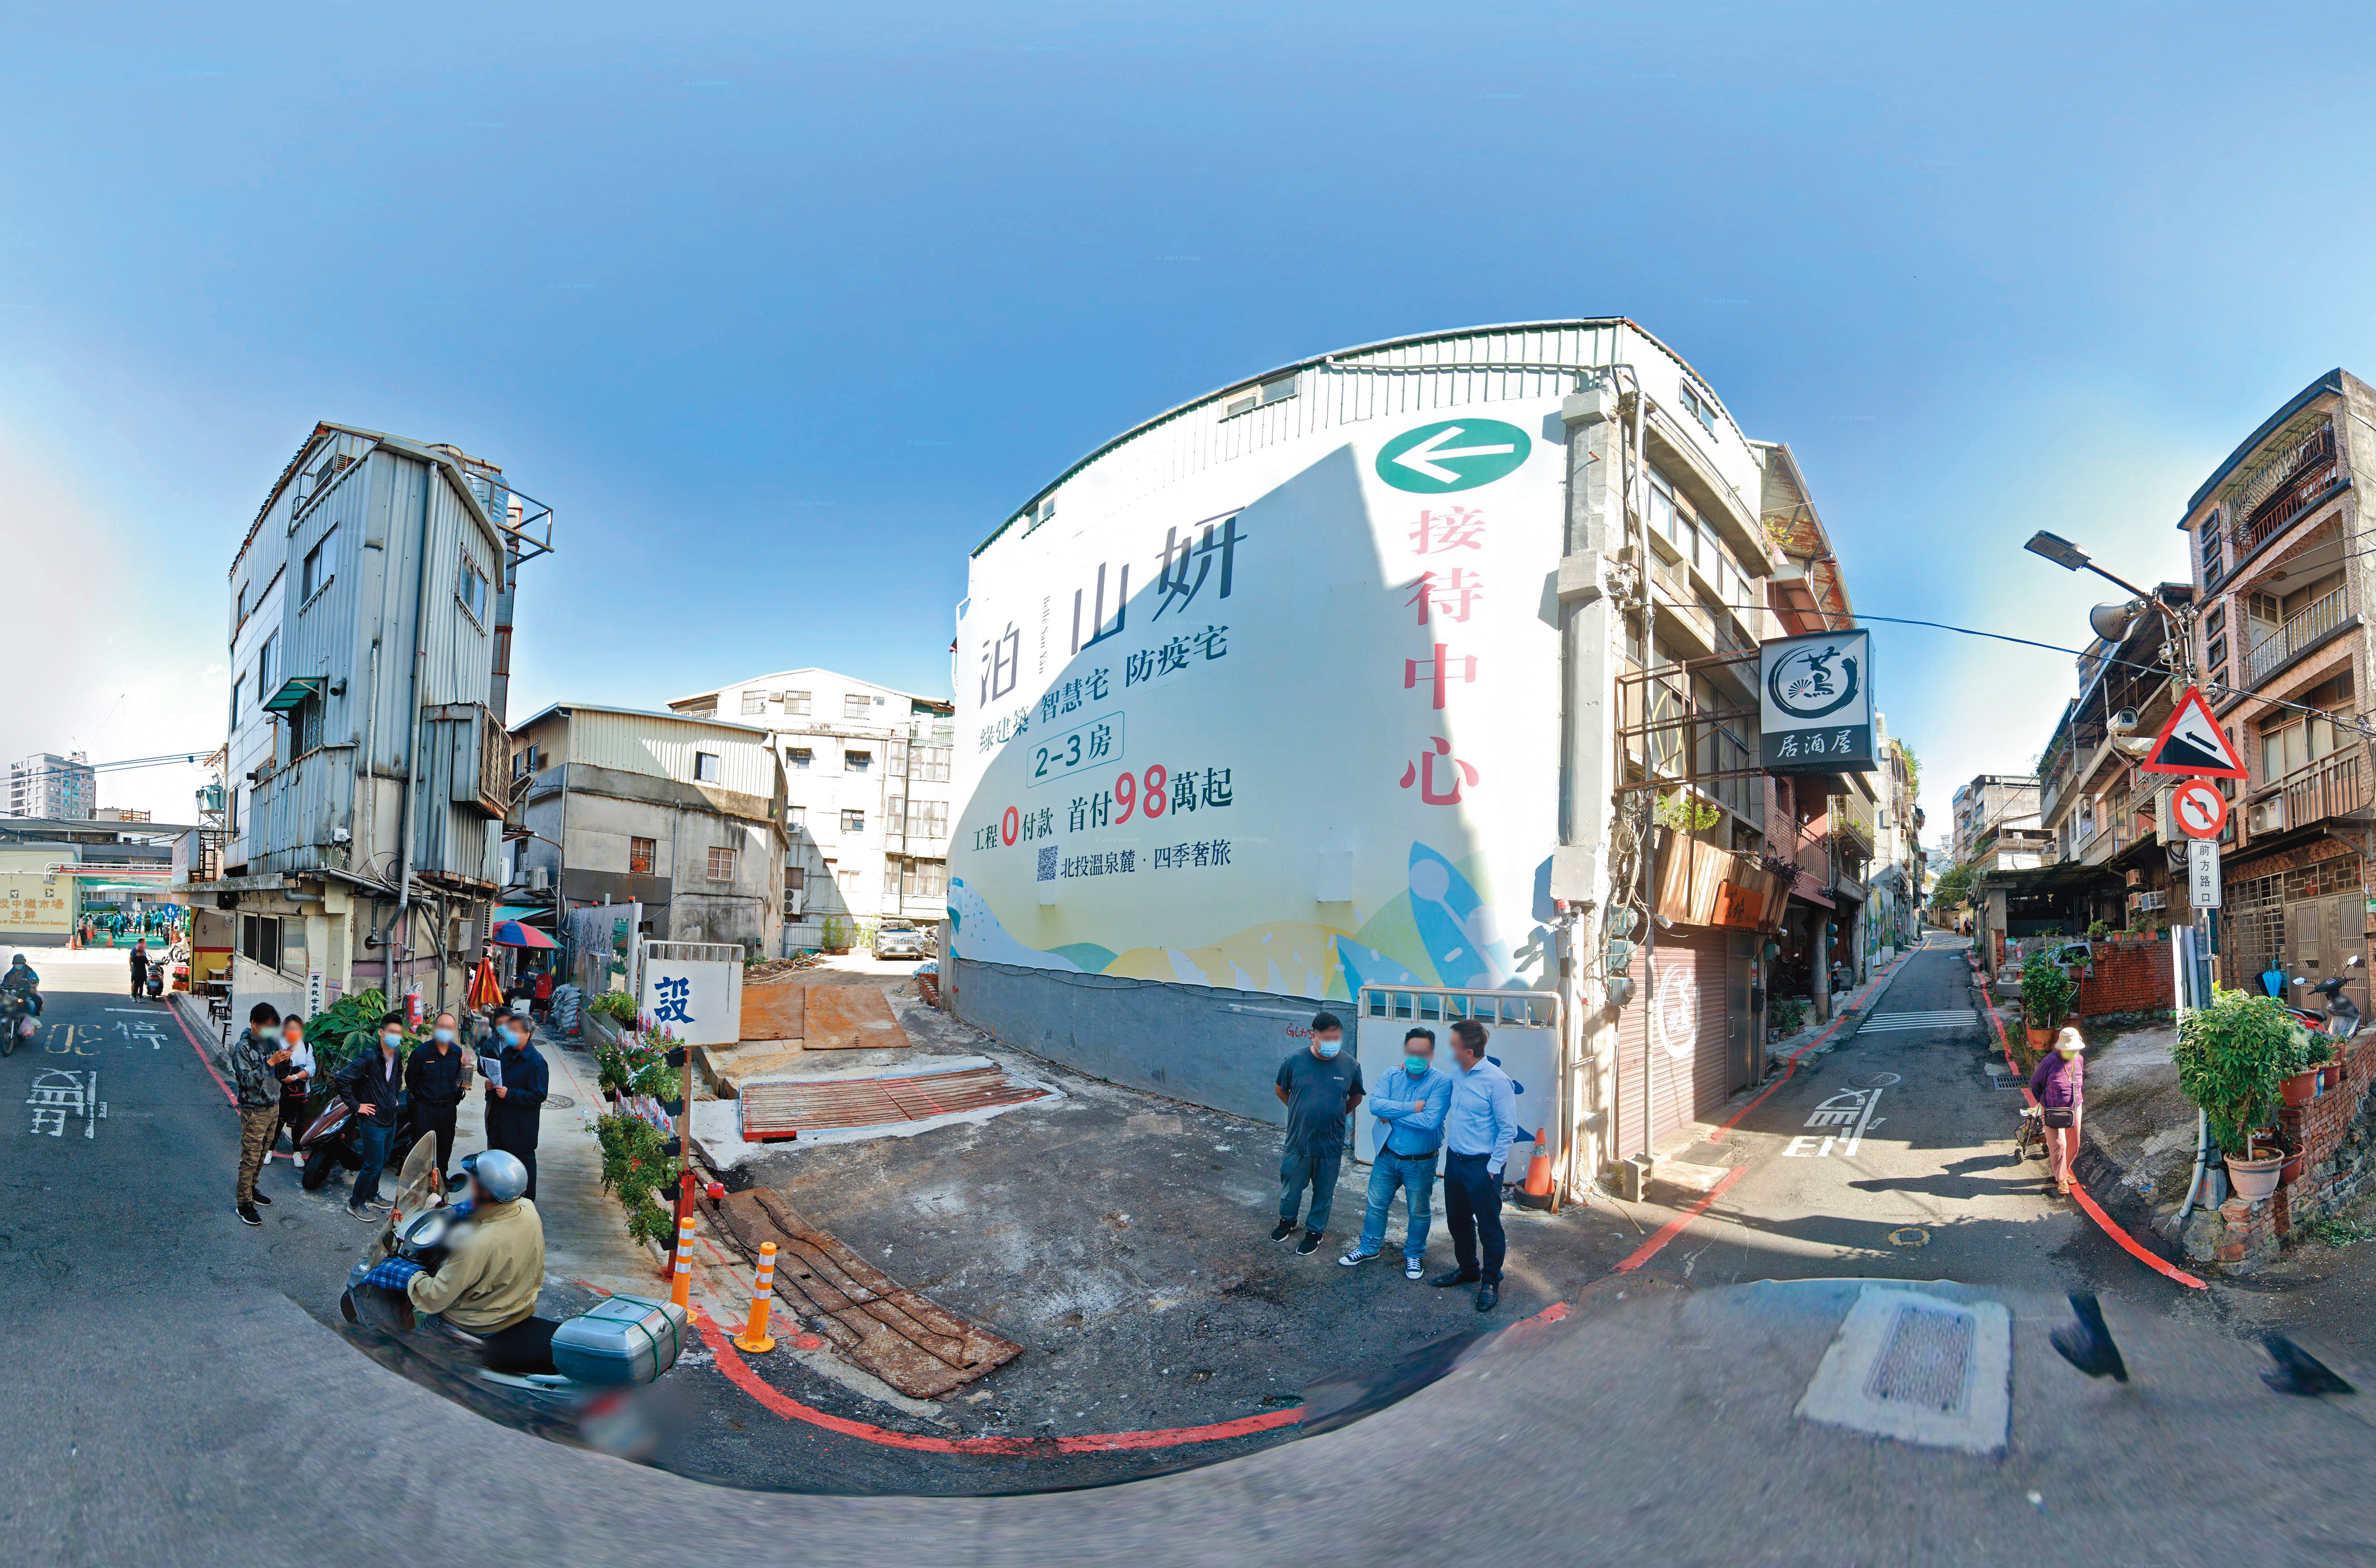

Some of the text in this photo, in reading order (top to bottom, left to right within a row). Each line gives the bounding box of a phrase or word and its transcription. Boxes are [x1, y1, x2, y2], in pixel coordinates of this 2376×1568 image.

[1040, 626, 1049, 649] San
[1399, 506, 1487, 806] 接待中心
[979, 625, 1229, 754] 綠建築 智慧宅 防疫宅
[1777, 729, 1852, 758] 居酒屋
[972, 764, 1233, 851] 工程0付款 首付98萬起
[2199, 844, 2210, 902] 前方路口
[11, 910, 36, 919] 生鮮
[654, 976, 695, 1024] 設
[26, 1067, 108, 1139] 慢
[1782, 1088, 1887, 1157] 慢
